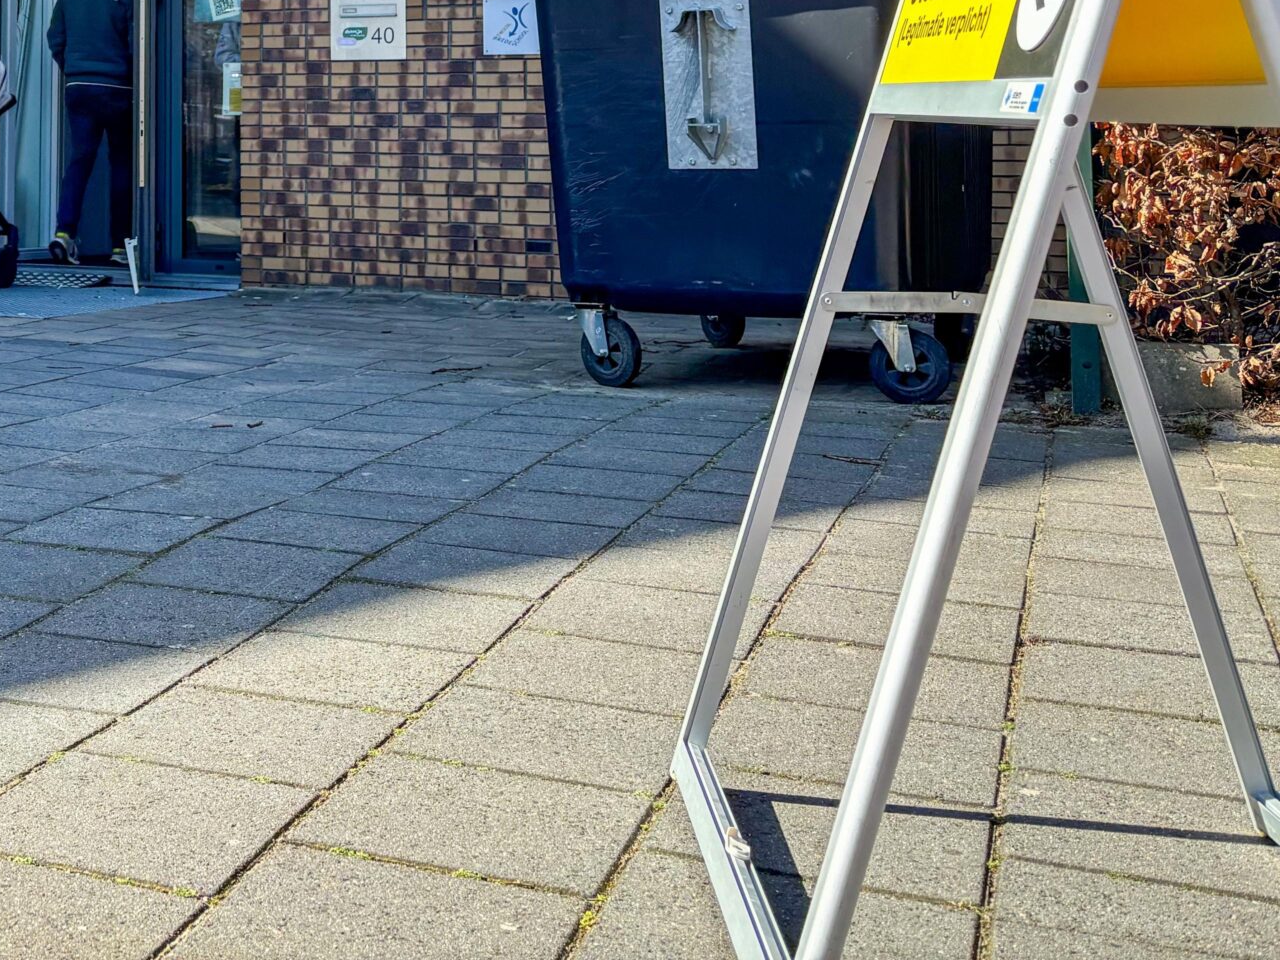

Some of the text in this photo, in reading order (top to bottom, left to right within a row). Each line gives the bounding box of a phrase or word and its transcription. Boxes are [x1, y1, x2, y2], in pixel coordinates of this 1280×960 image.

[371, 27, 395, 44] 40
[897, 3, 993, 48] (Legitimatie verplicht)
